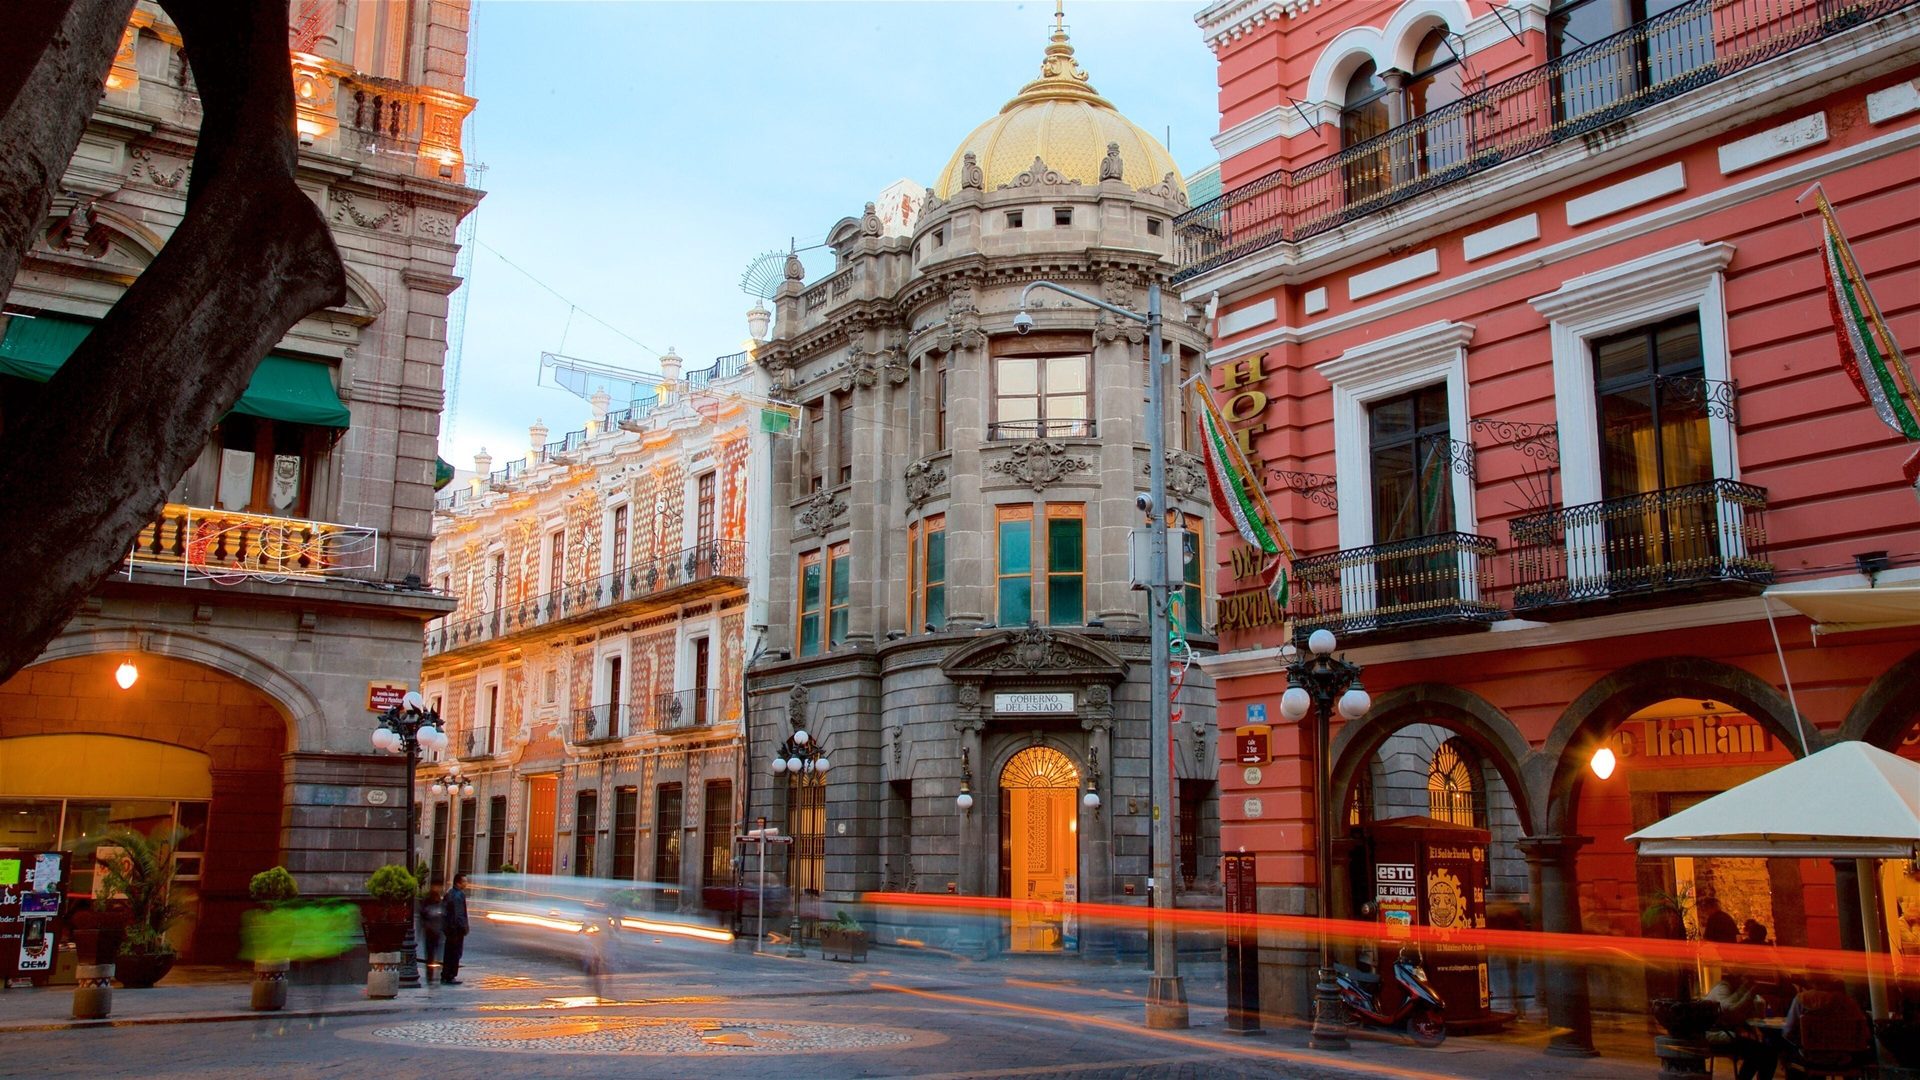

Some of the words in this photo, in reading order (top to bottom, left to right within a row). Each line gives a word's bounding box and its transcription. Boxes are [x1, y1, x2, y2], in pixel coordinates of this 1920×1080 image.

[1220, 352, 1270, 525] HOTE
[1010, 695, 1058, 703] GOBIERNO
[1005, 703, 1023, 711] DEL
[1026, 703, 1063, 711] ESTADO
[1645, 714, 1766, 757] Italian
[1380, 886, 1387, 895] DE
[1389, 887, 1415, 896] PUEBLA
